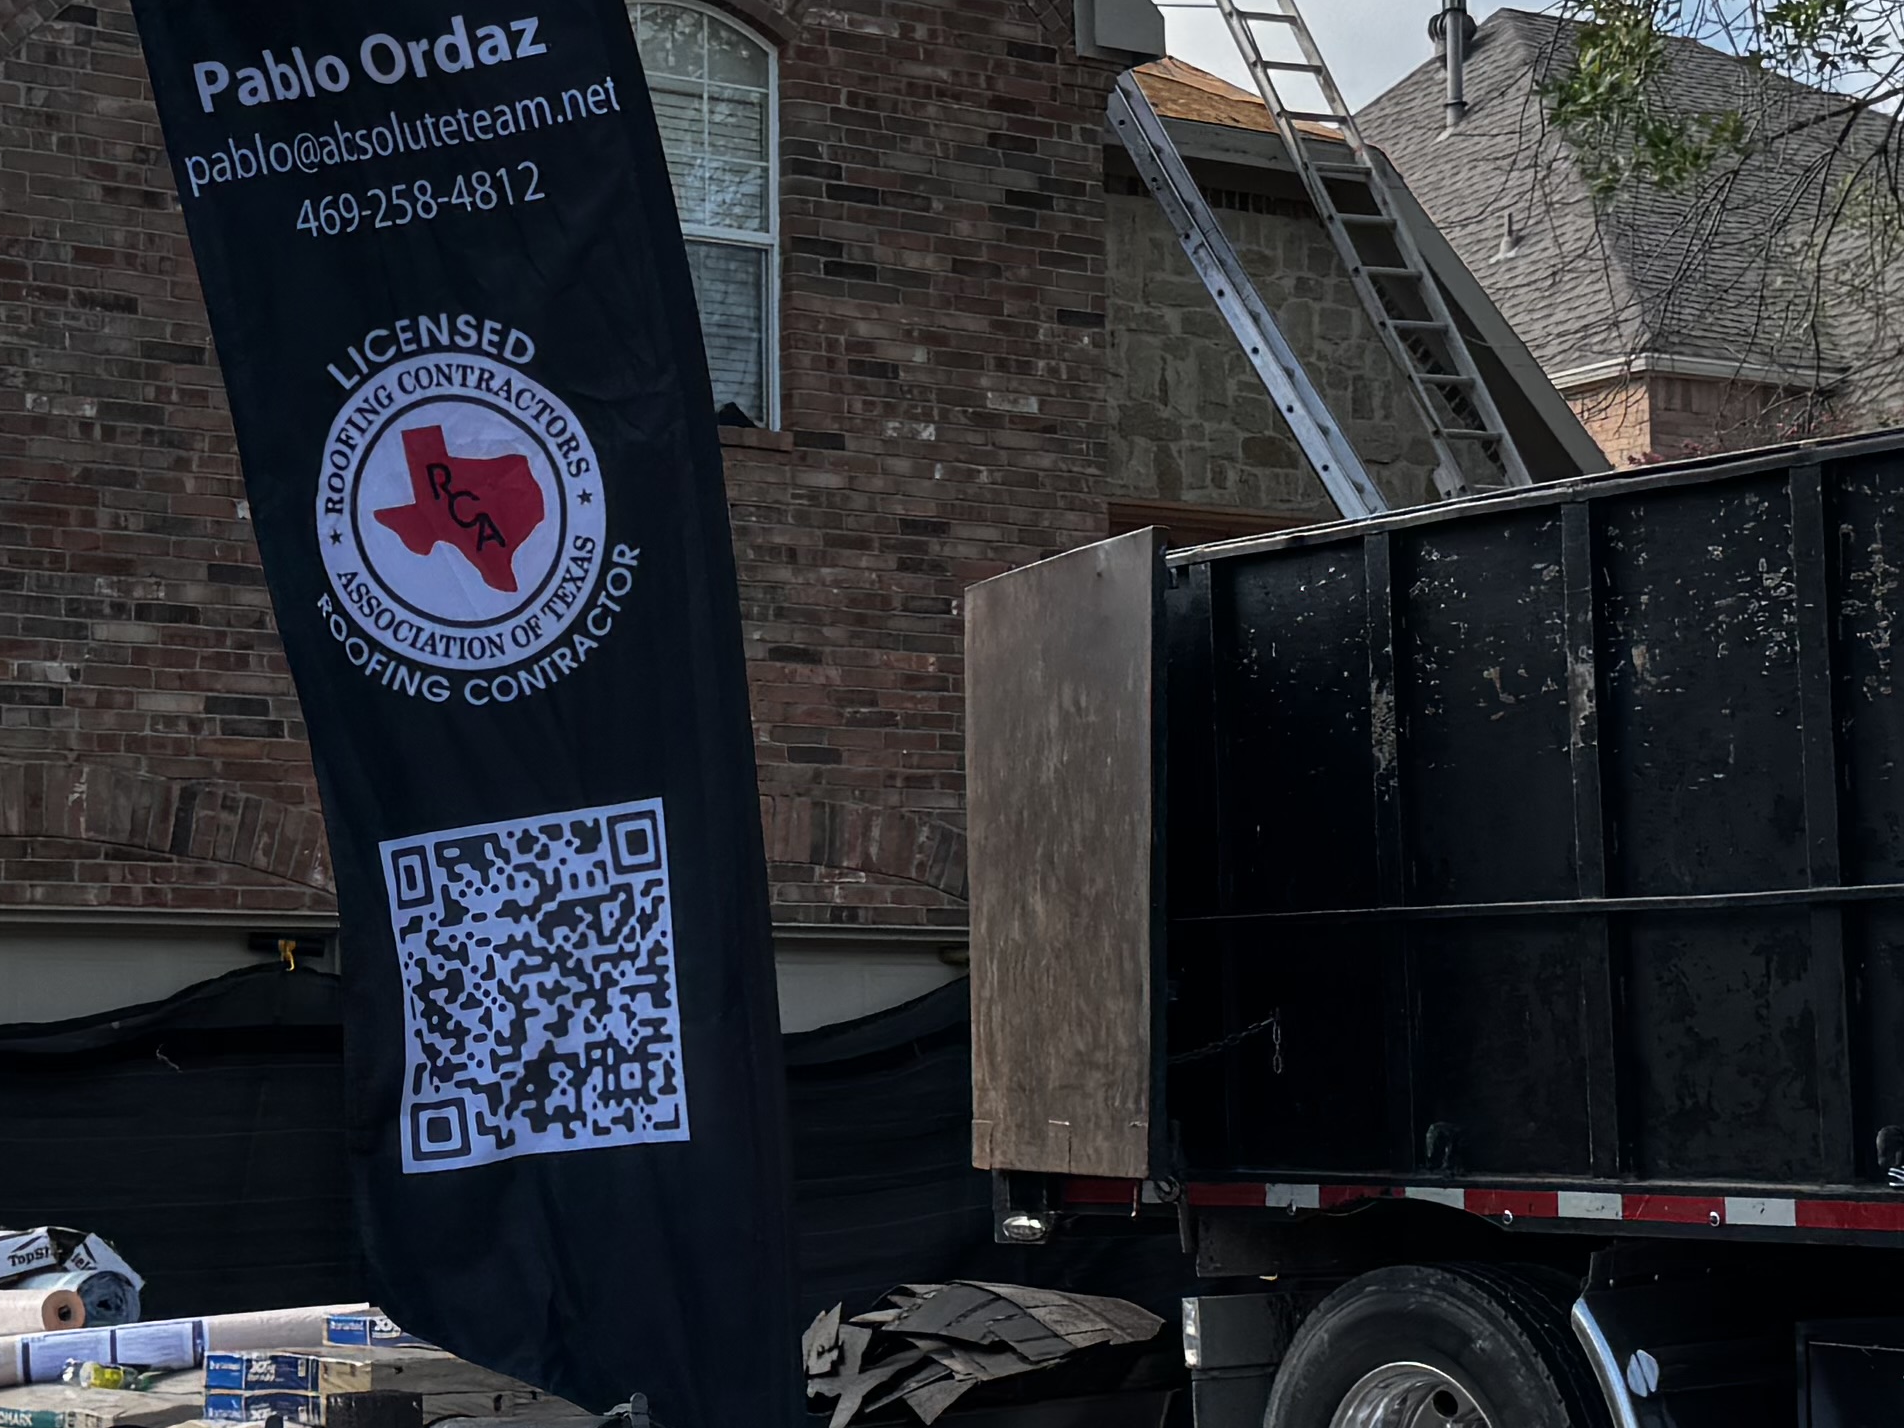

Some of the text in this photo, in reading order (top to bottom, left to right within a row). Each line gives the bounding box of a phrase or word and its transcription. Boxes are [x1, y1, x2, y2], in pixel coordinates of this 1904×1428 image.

[193, 15, 547, 113] Pablo Ordaz
[184, 76, 621, 197] pablo@absoluteteam.net
[296, 161, 545, 238] 469-258-4812
[327, 313, 535, 390] LICENSED
[325, 363, 591, 516] ROOFING CONTRACTORS
[317, 543, 641, 705] ROOFING CONTRACTOR
[337, 535, 595, 661] ASSOCIATION OF TEXAS
